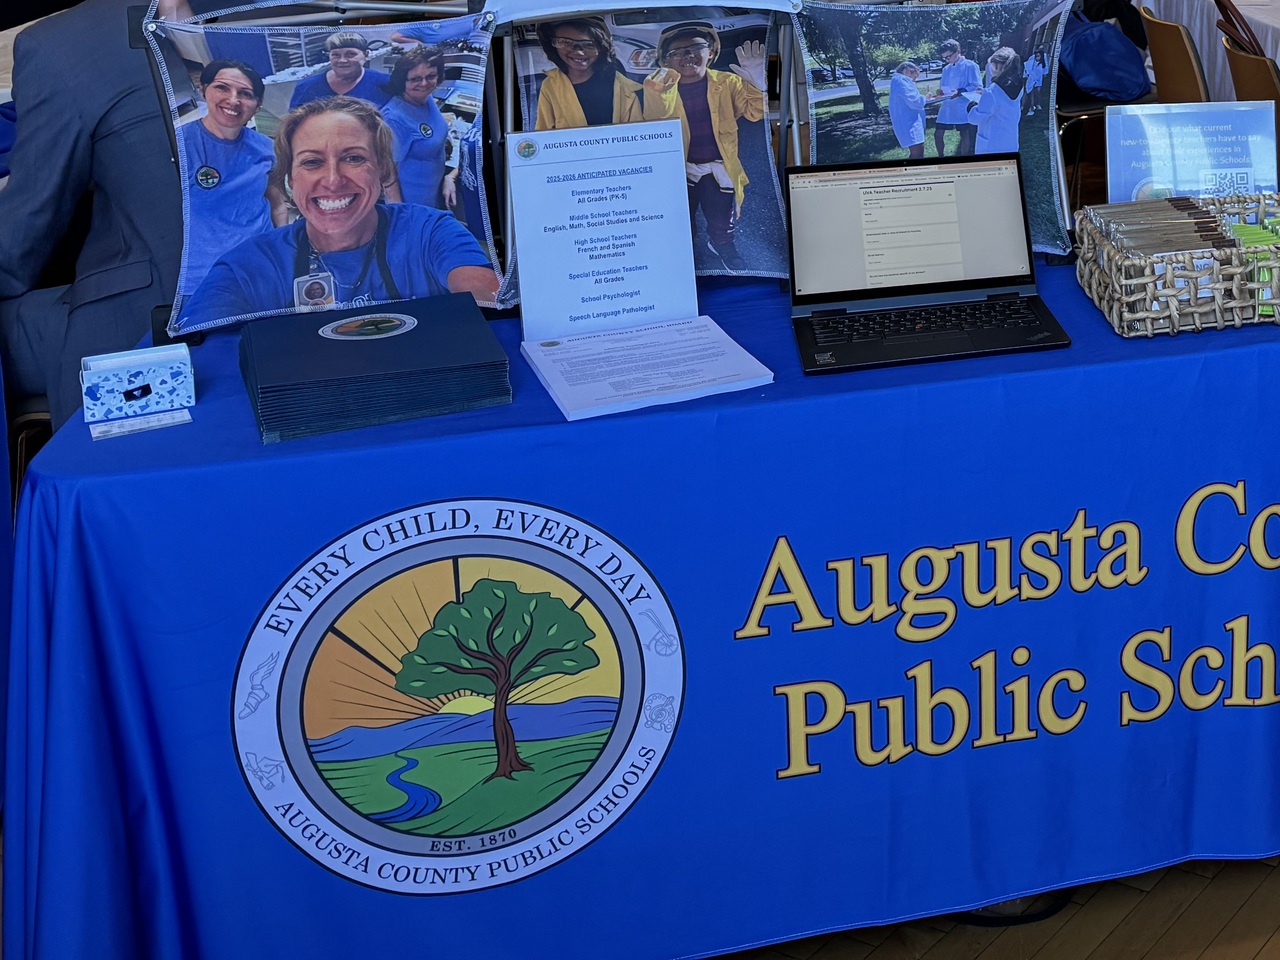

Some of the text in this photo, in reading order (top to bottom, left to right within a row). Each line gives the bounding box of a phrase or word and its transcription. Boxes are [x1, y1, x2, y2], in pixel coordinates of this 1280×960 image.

[1203, 123, 1232, 132] current
[543, 131, 673, 150] AUGUSTA COUNTY PUBLIC SCHOOLS
[1218, 134, 1237, 143] have
[546, 165, 653, 183] 2025-2026 ANTICIPATED VACANCIES
[571, 184, 632, 198] Elementary Teachers
[586, 195, 608, 204] Grades
[609, 192, 628, 202] (PK-5)
[569, 208, 638, 221] Middle School Teachers
[543, 213, 664, 234] English, Math, Social Studies and Science
[574, 233, 637, 247] High School Teachers
[577, 241, 636, 254] French and Spanish
[588, 251, 626, 261] Mathematics
[568, 264, 649, 281] Special Education Teachers
[603, 276, 625, 284] Grades
[580, 289, 641, 304] School Psychologist
[568, 304, 655, 323] Speech Language Pathologist
[264, 507, 652, 638] EVERY CHILD, EVERY DAY
[733, 507, 1149, 643] Augusta
[774, 645, 1089, 780] Public
[273, 744, 657, 887] AUGUSTA COUNTY PUBLIC SCHOOLS
[428, 827, 518, 853] EST. 1870
